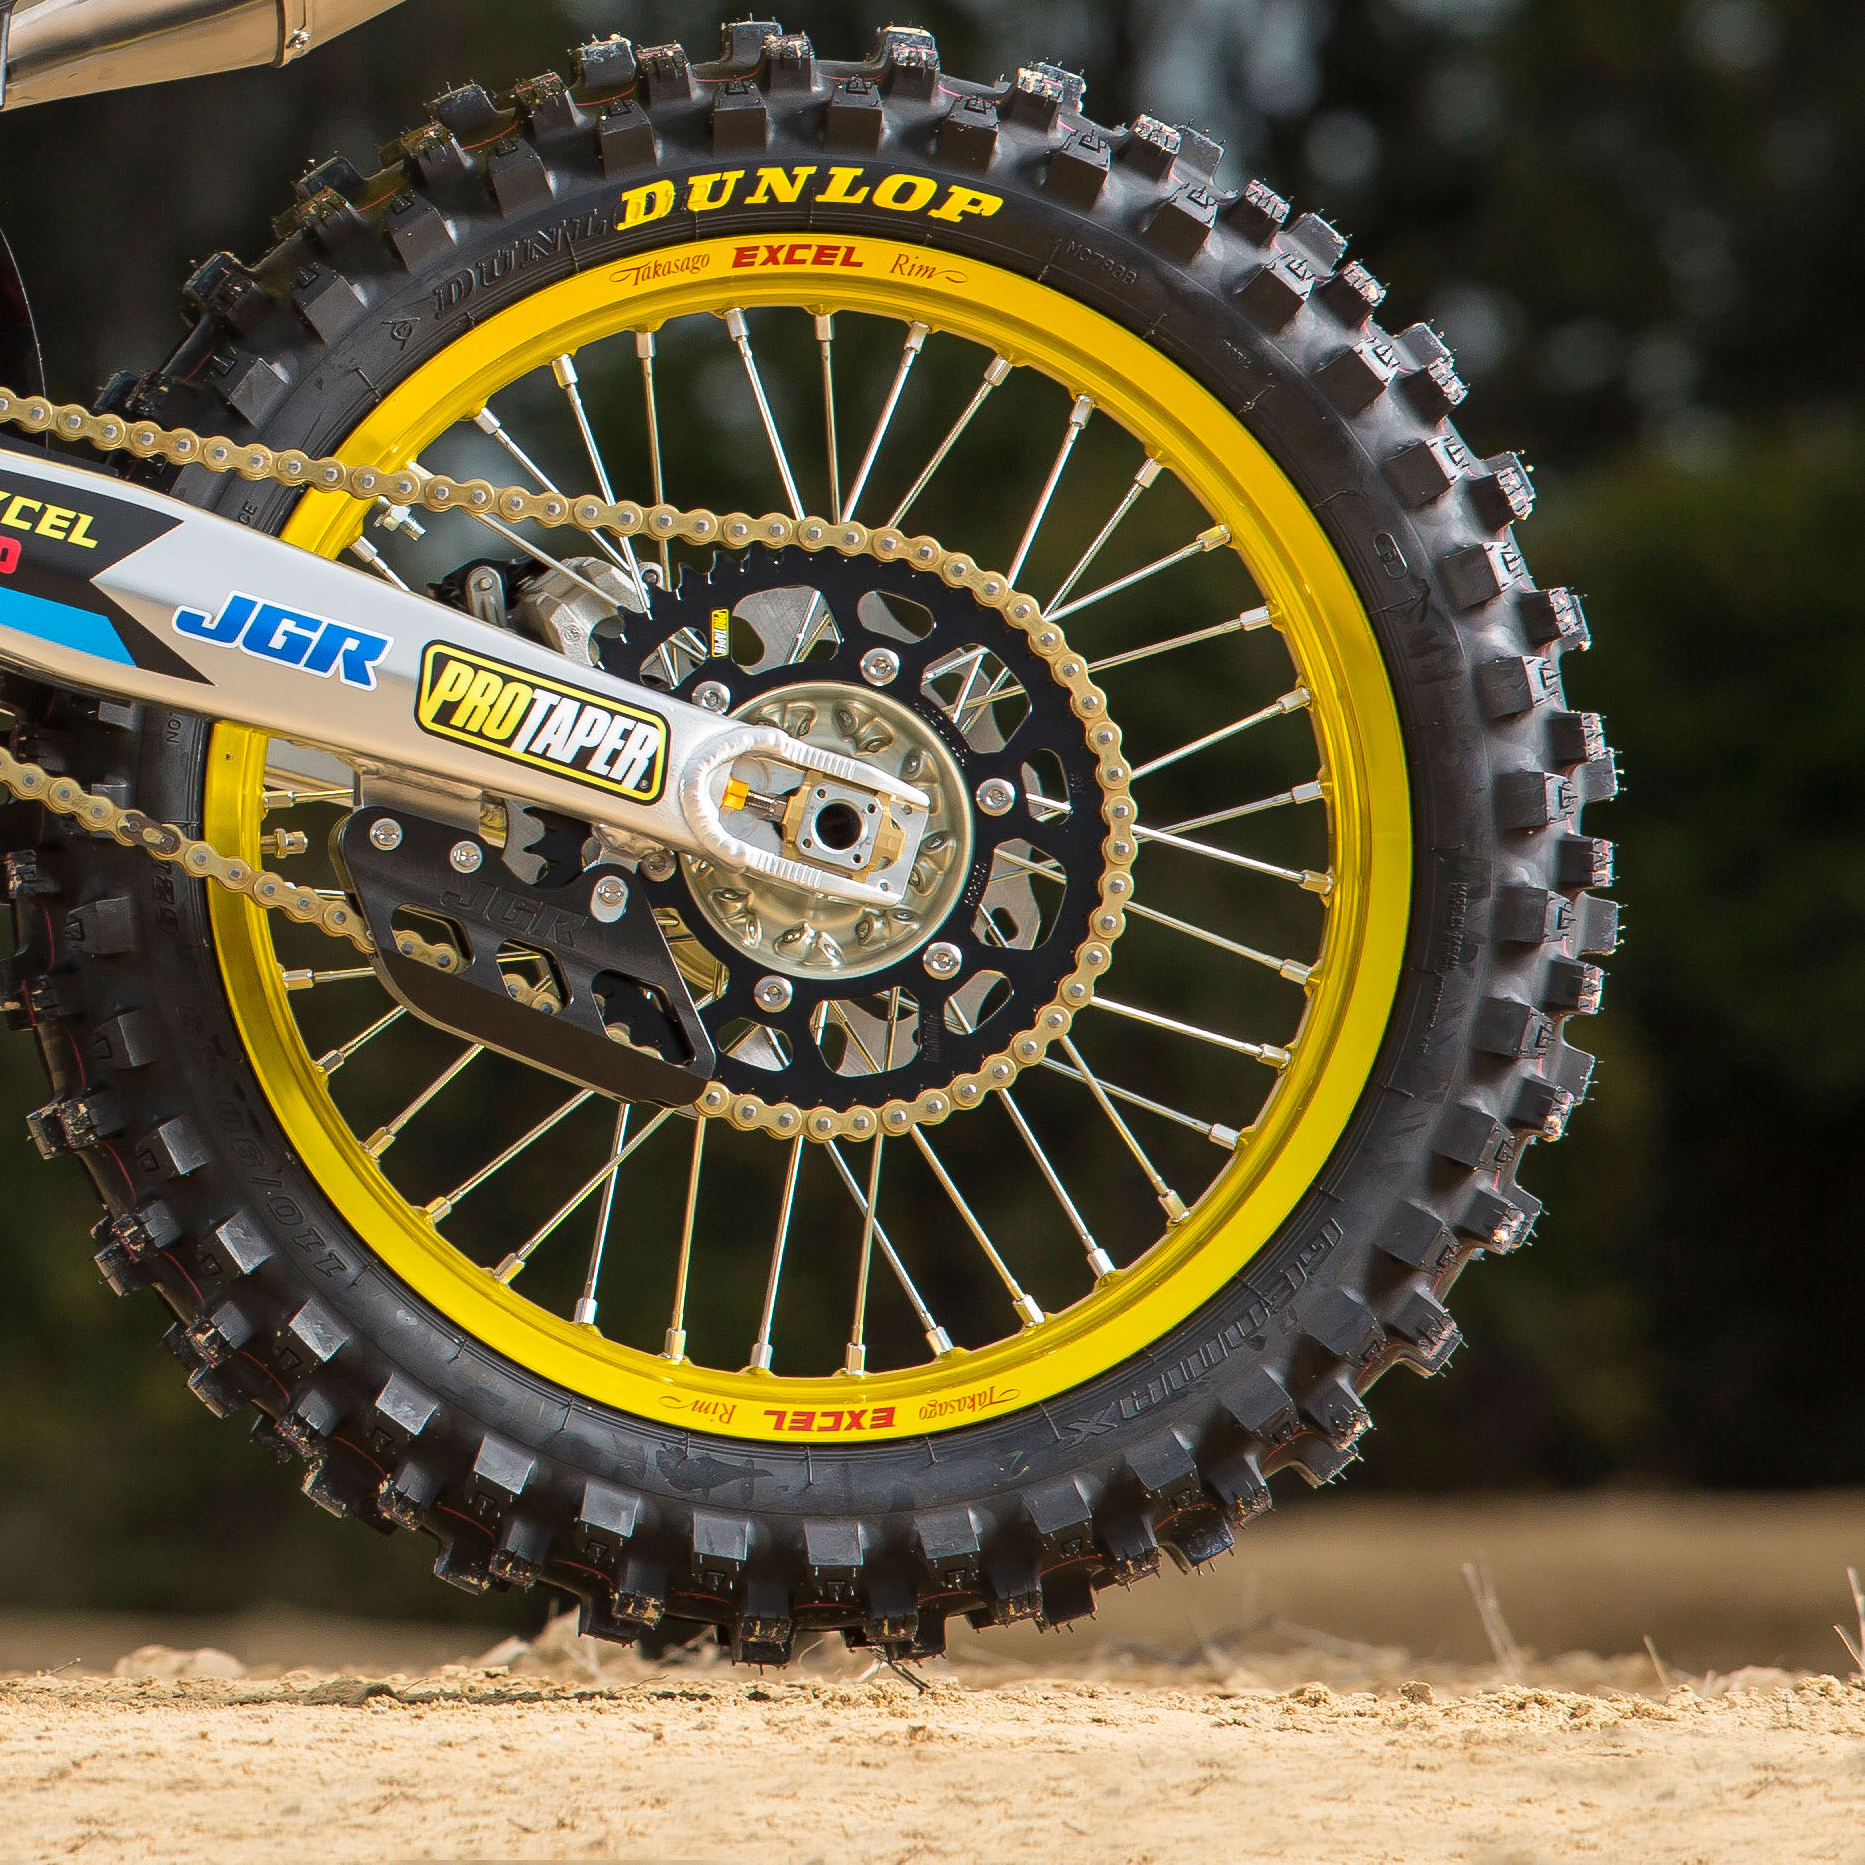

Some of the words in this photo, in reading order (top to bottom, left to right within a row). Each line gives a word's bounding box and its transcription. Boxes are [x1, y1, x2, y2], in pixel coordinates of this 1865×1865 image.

[617, 166, 1003, 231] DUNLOP
[610, 251, 711, 287] Takasago
[731, 244, 864, 269] EXCEL
[890, 253, 969, 286] Rim
[171, 590, 395, 691] JGR
[429, 662, 661, 787] PROTAPER
[439, 880, 589, 948] JGR
[657, 1393, 737, 1426] Rim
[762, 1405, 897, 1433] EXCEL
[918, 1383, 1021, 1422] Takasago
